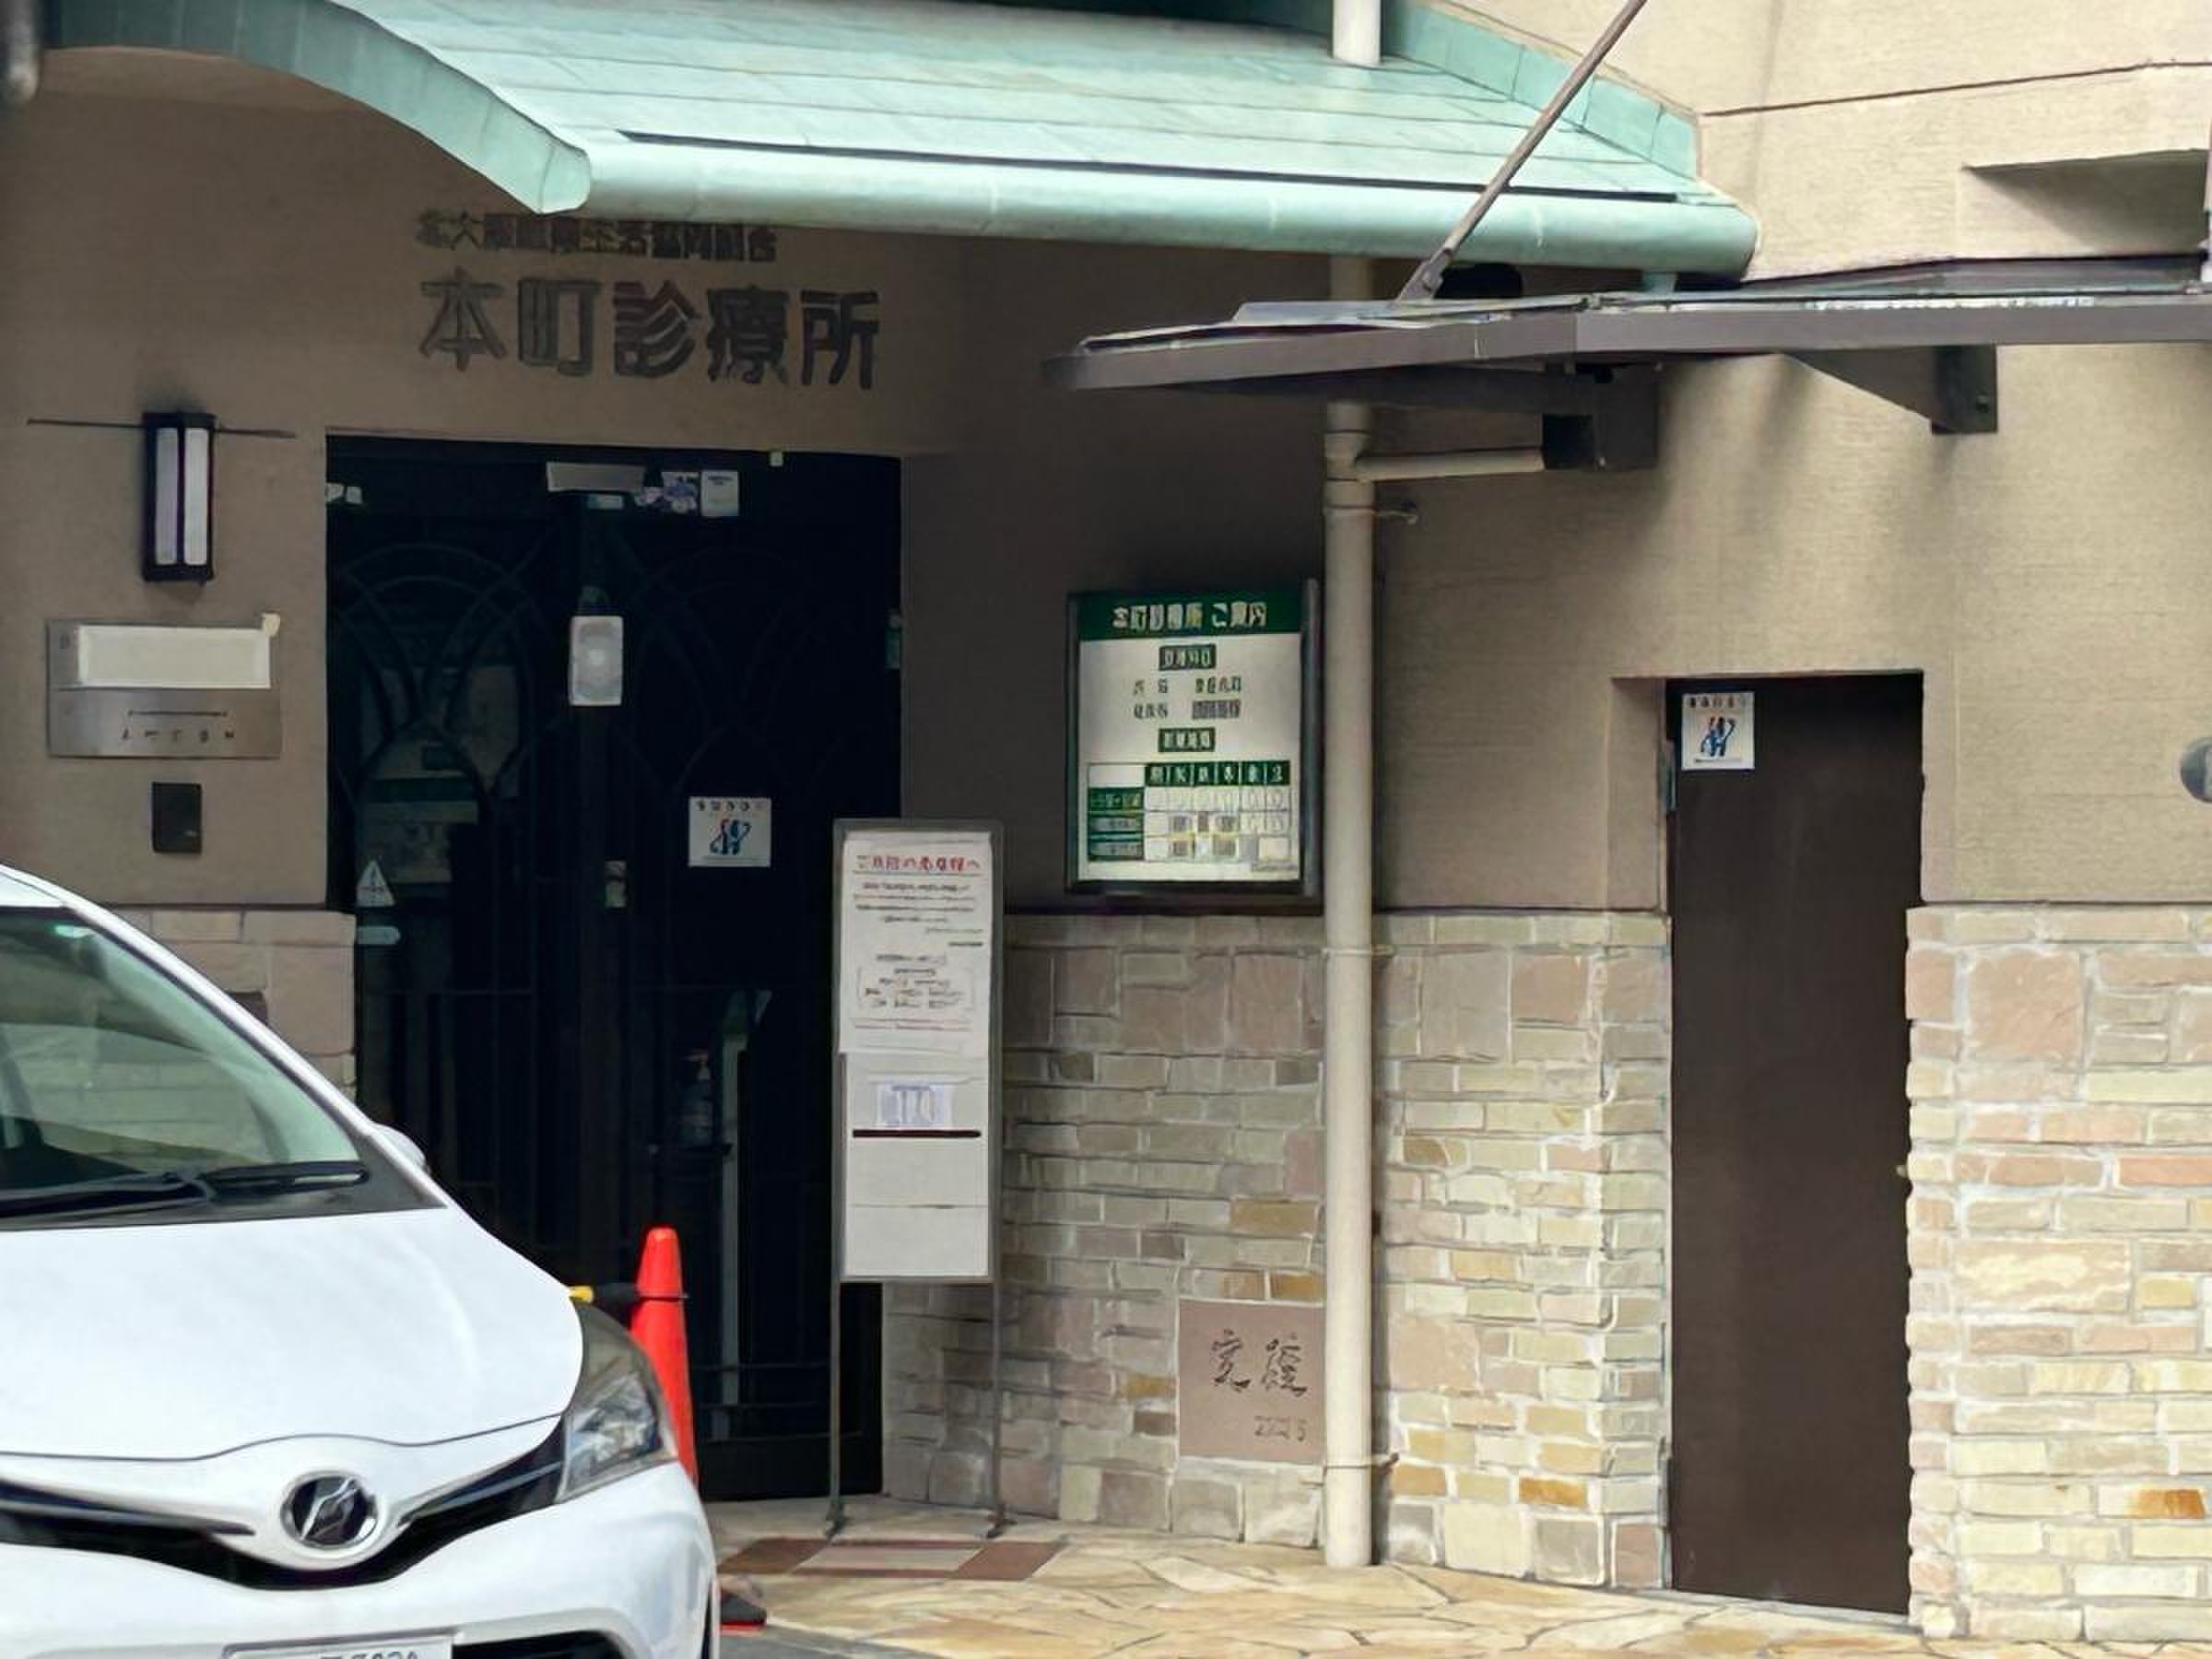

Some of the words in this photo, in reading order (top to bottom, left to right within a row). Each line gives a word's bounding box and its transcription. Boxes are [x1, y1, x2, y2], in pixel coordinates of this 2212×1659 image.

[419, 267, 880, 389] 本町診療所
